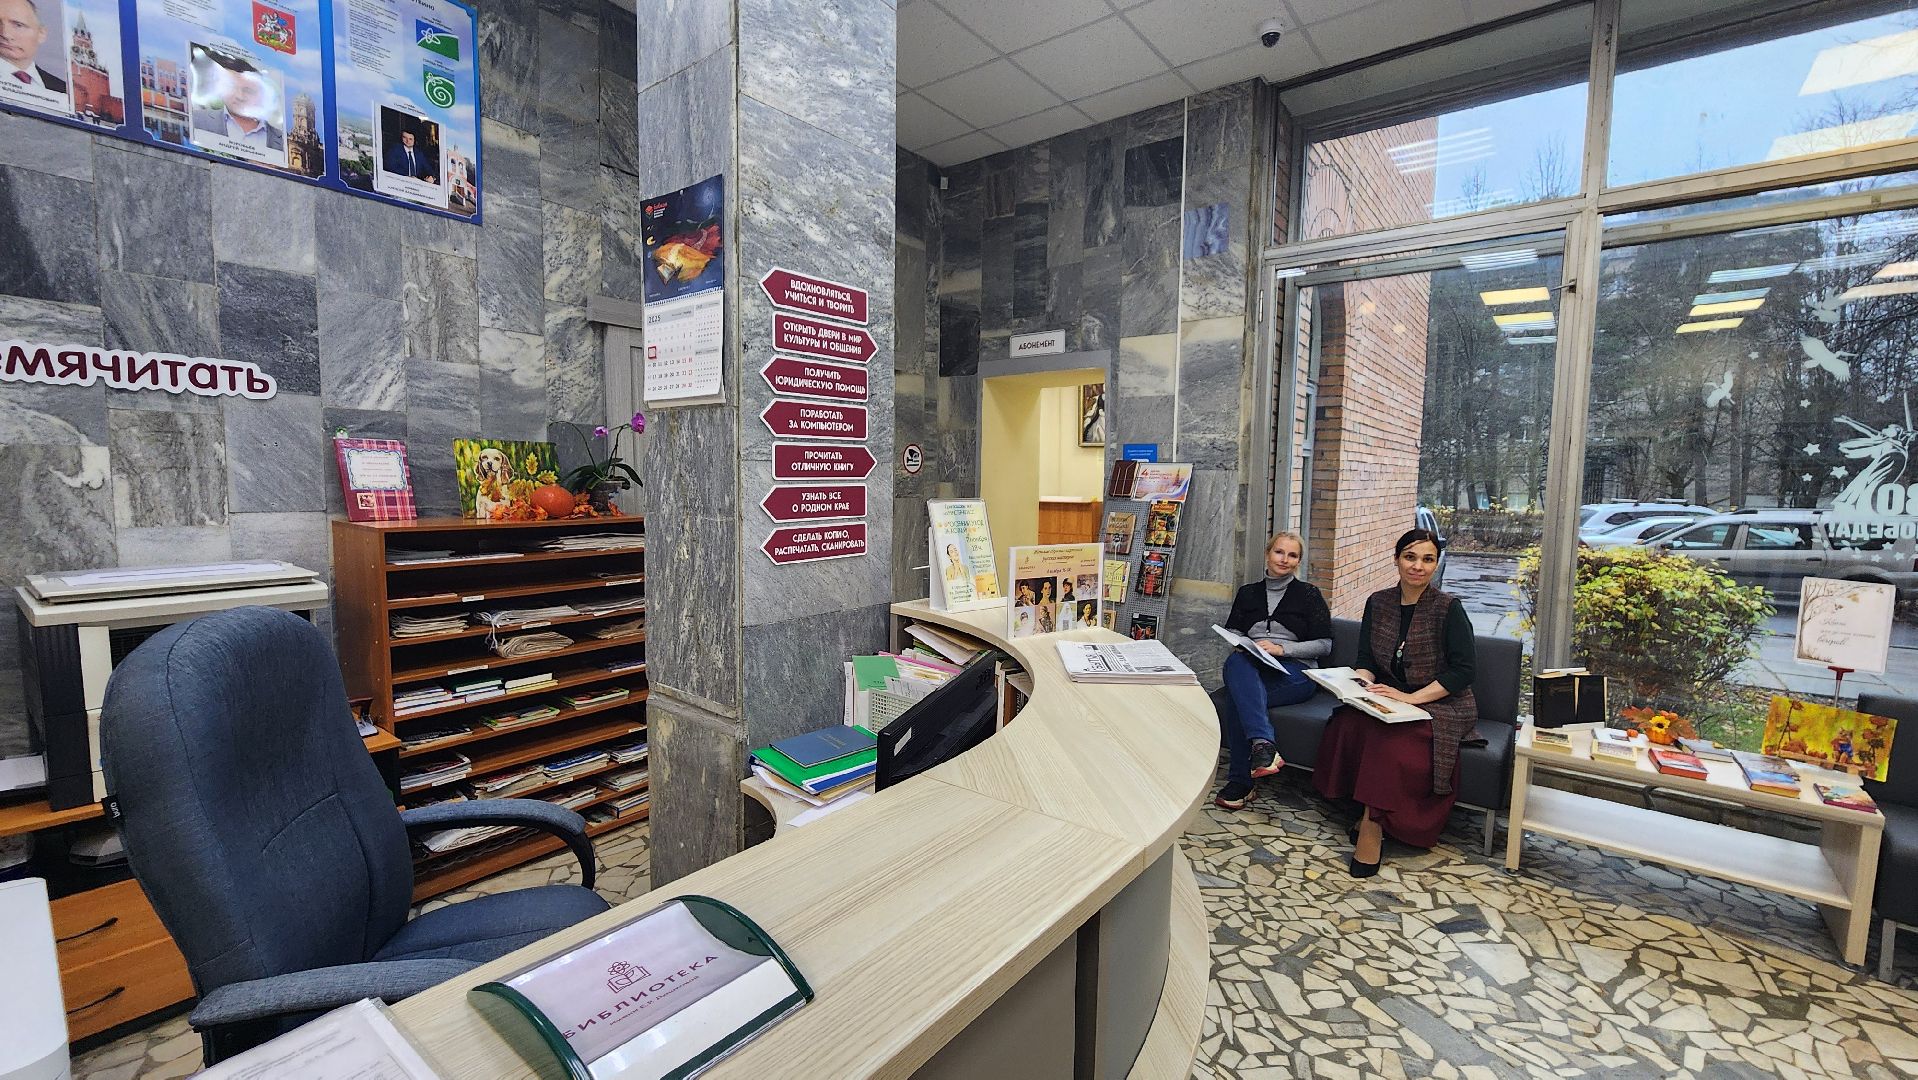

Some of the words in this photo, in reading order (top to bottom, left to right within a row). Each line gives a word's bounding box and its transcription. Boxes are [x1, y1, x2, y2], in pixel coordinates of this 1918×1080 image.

[790, 279, 853, 303] ВДОХНОВЛЯТЬСЯ,
[784, 289, 817, 306] УЧИТЬСЯ
[818, 297, 825, 307] И
[827, 298, 855, 314] ТВОРИТЬ
[783, 321, 817, 336] ОТКРЫТЬ
[818, 328, 841, 341] ДВЕРИ
[841, 331, 846, 341] В
[848, 333, 862, 344] МИР
[783, 333, 821, 348] КУЛЬТУРЫ
[822, 338, 828, 349] И
[830, 341, 862, 355] ОБЩЕНИЯ
[1018, 339, 1056, 351] АБОНЕМЕНТ
[0, 345, 270, 394] мячитать
[804, 367, 842, 380] ПОЛУЧИТЬ
[775, 375, 833, 390] ЮРИДИЧЕСКУЮ
[835, 382, 866, 395] ПОМОЩЬ
[800, 408, 844, 420] ПОРАБОТАТЬ
[788, 419, 799, 429] ЗА
[800, 420, 854, 432] КОМПЬЮТЕРОМ
[804, 450, 843, 460] ПРОЧИТАТЬ
[791, 461, 832, 471] ОТЛИЧНУЮ
[833, 462, 854, 472] КНИГУ
[801, 491, 827, 501] УЗНАТЬ
[828, 491, 842, 500] ВСЕ
[792, 503, 799, 513] О
[801, 503, 832, 513] РОДНОМ
[834, 502, 850, 511] КРАЕ
[792, 531, 823, 543] СДЕЛАТЬ
[774, 541, 820, 556] РАСПЕЧАТАТЬ,
[821, 540, 865, 552] СКАНИРОВАТЬ
[562, 955, 719, 1040] БИБЛИОТЕКА
